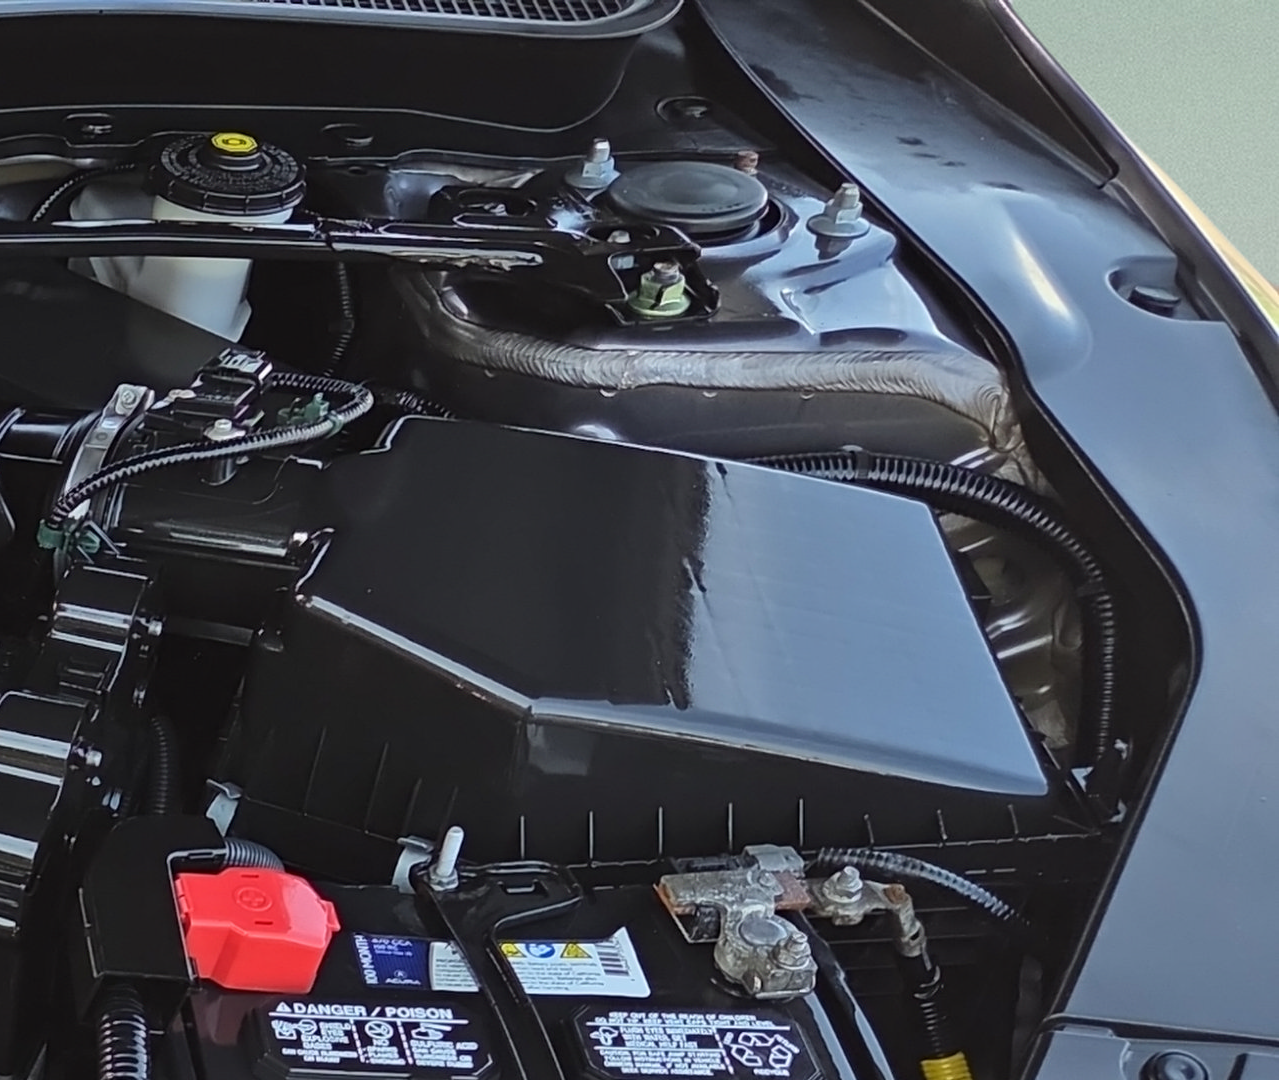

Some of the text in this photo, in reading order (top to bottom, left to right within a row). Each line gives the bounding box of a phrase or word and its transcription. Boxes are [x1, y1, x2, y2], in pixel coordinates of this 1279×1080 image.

[293, 1003, 453, 1020] DANGER / POISON
